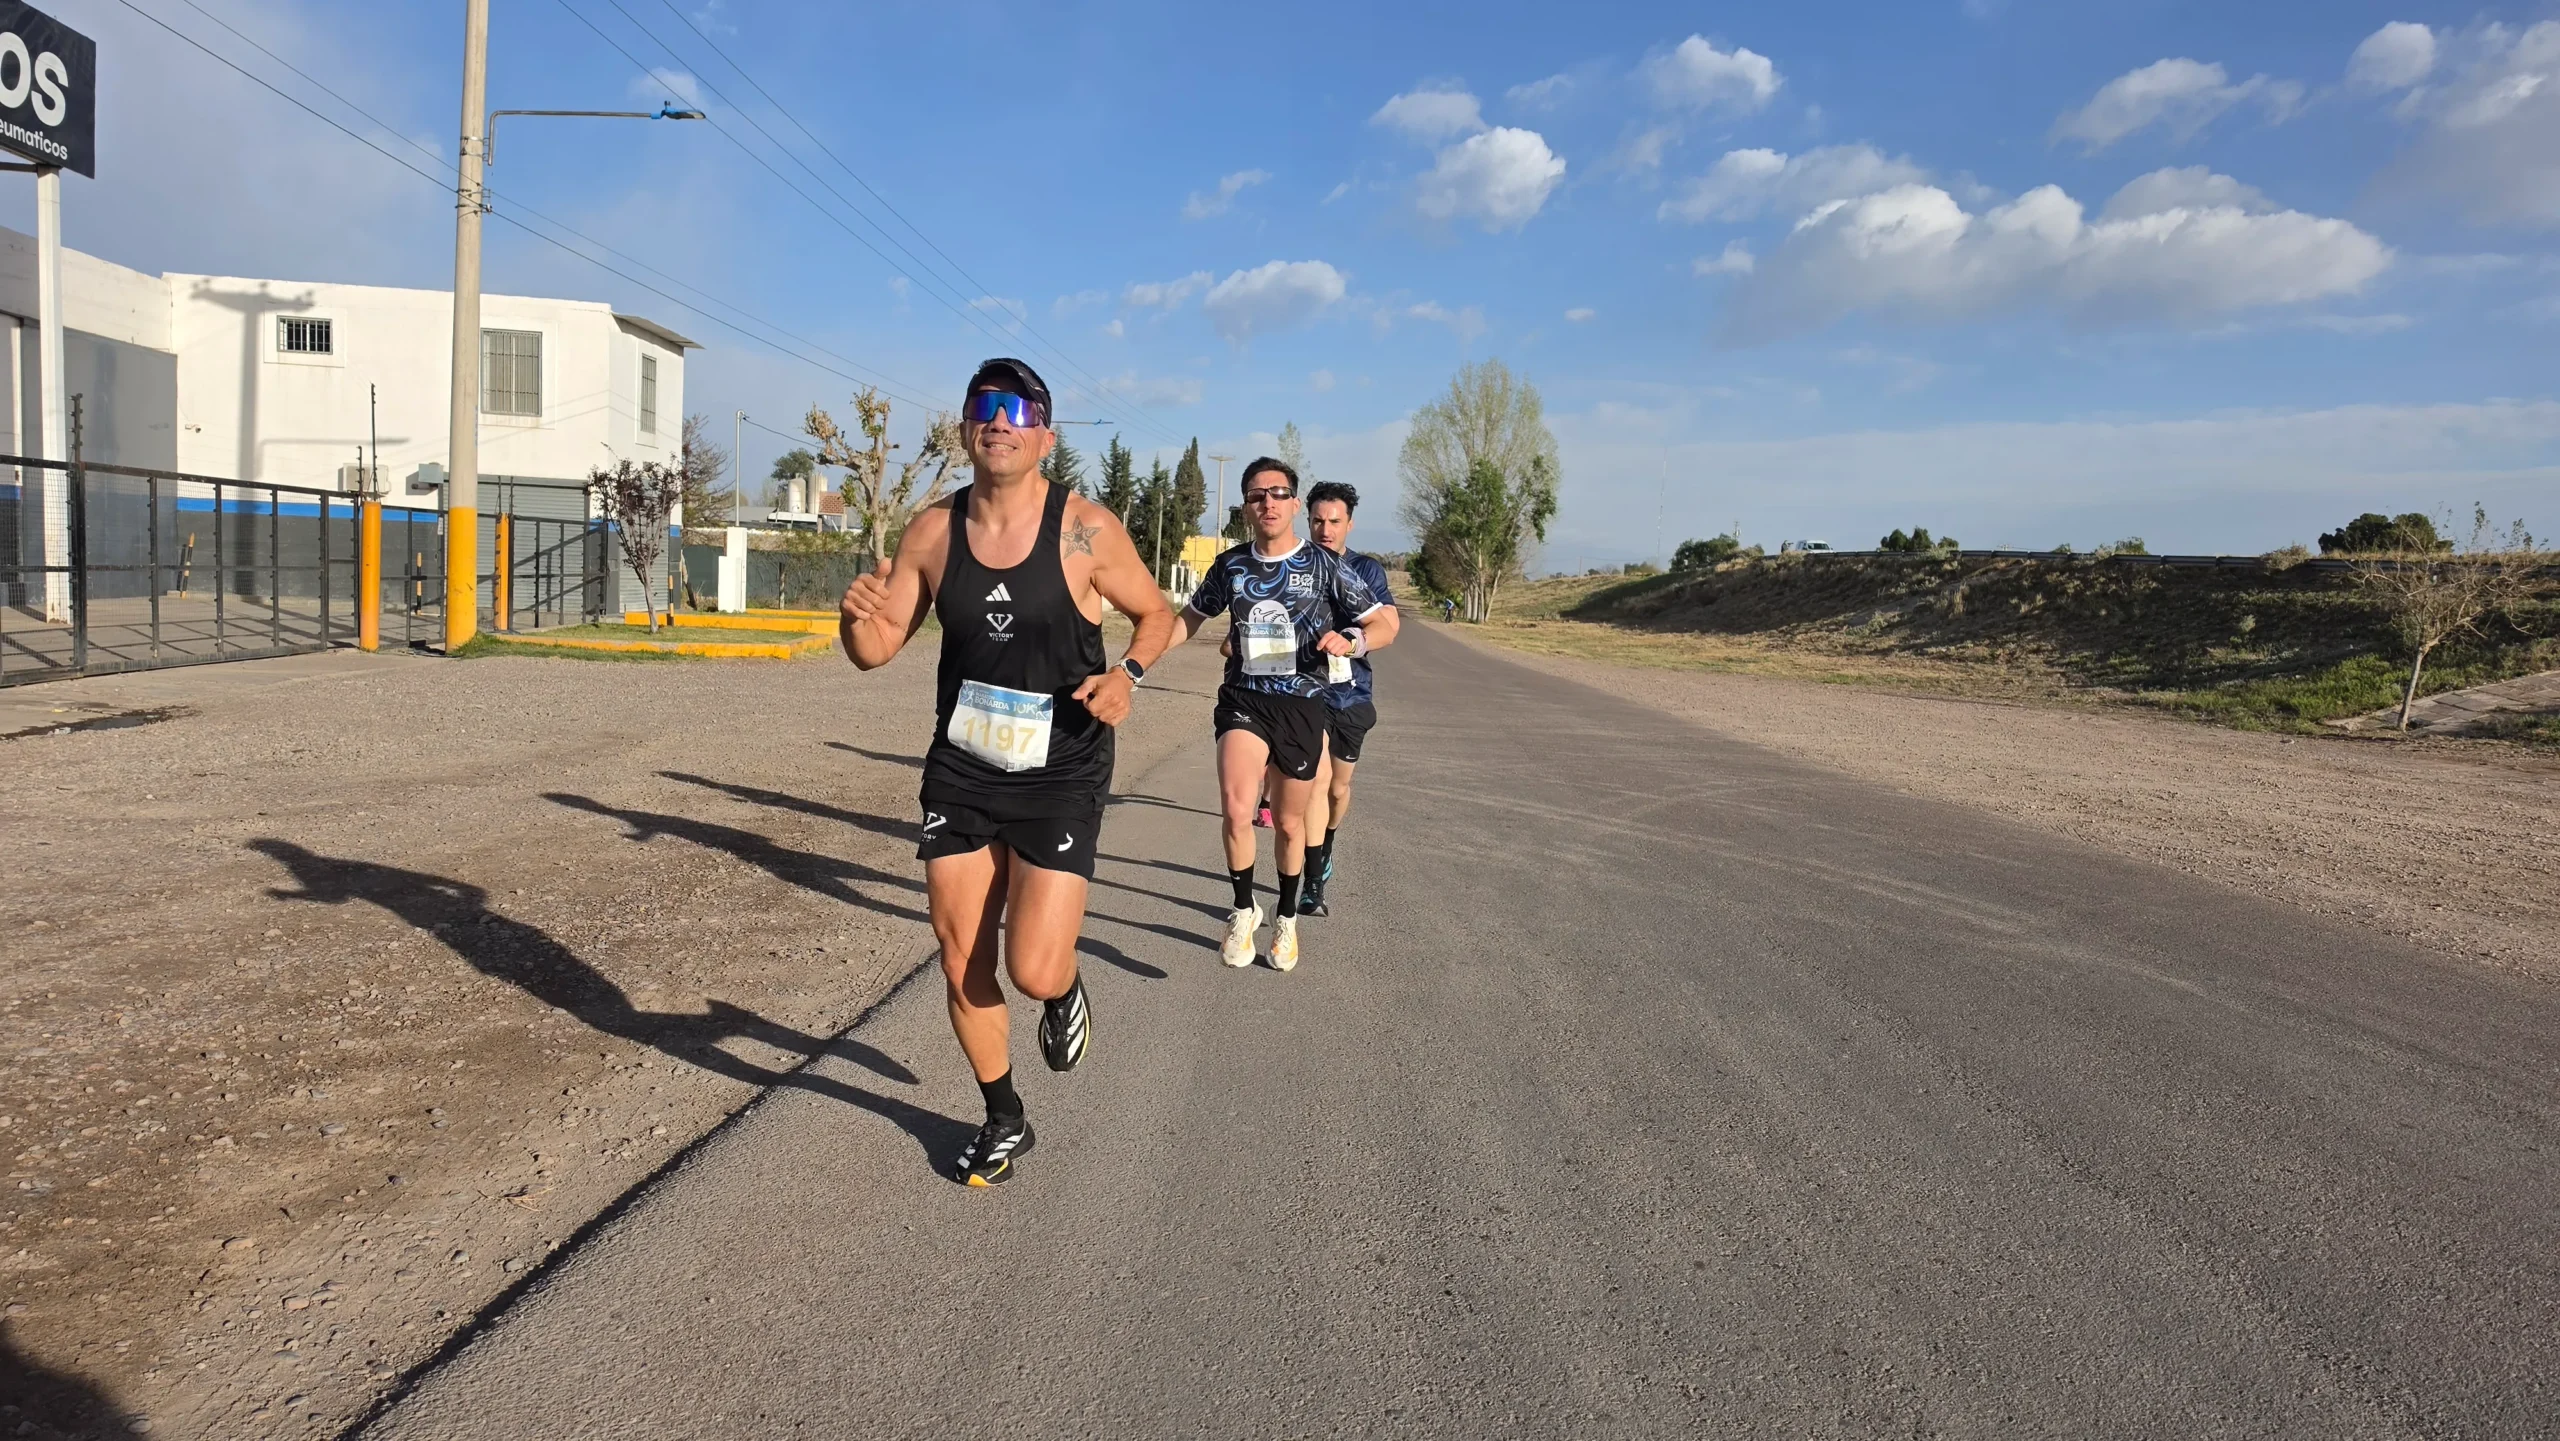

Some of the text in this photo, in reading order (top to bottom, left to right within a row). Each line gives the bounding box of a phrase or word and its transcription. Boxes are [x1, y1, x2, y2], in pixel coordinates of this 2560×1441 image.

[974, 696, 1037, 715] BONARDA 10K
[963, 716, 1037, 754] 1197
